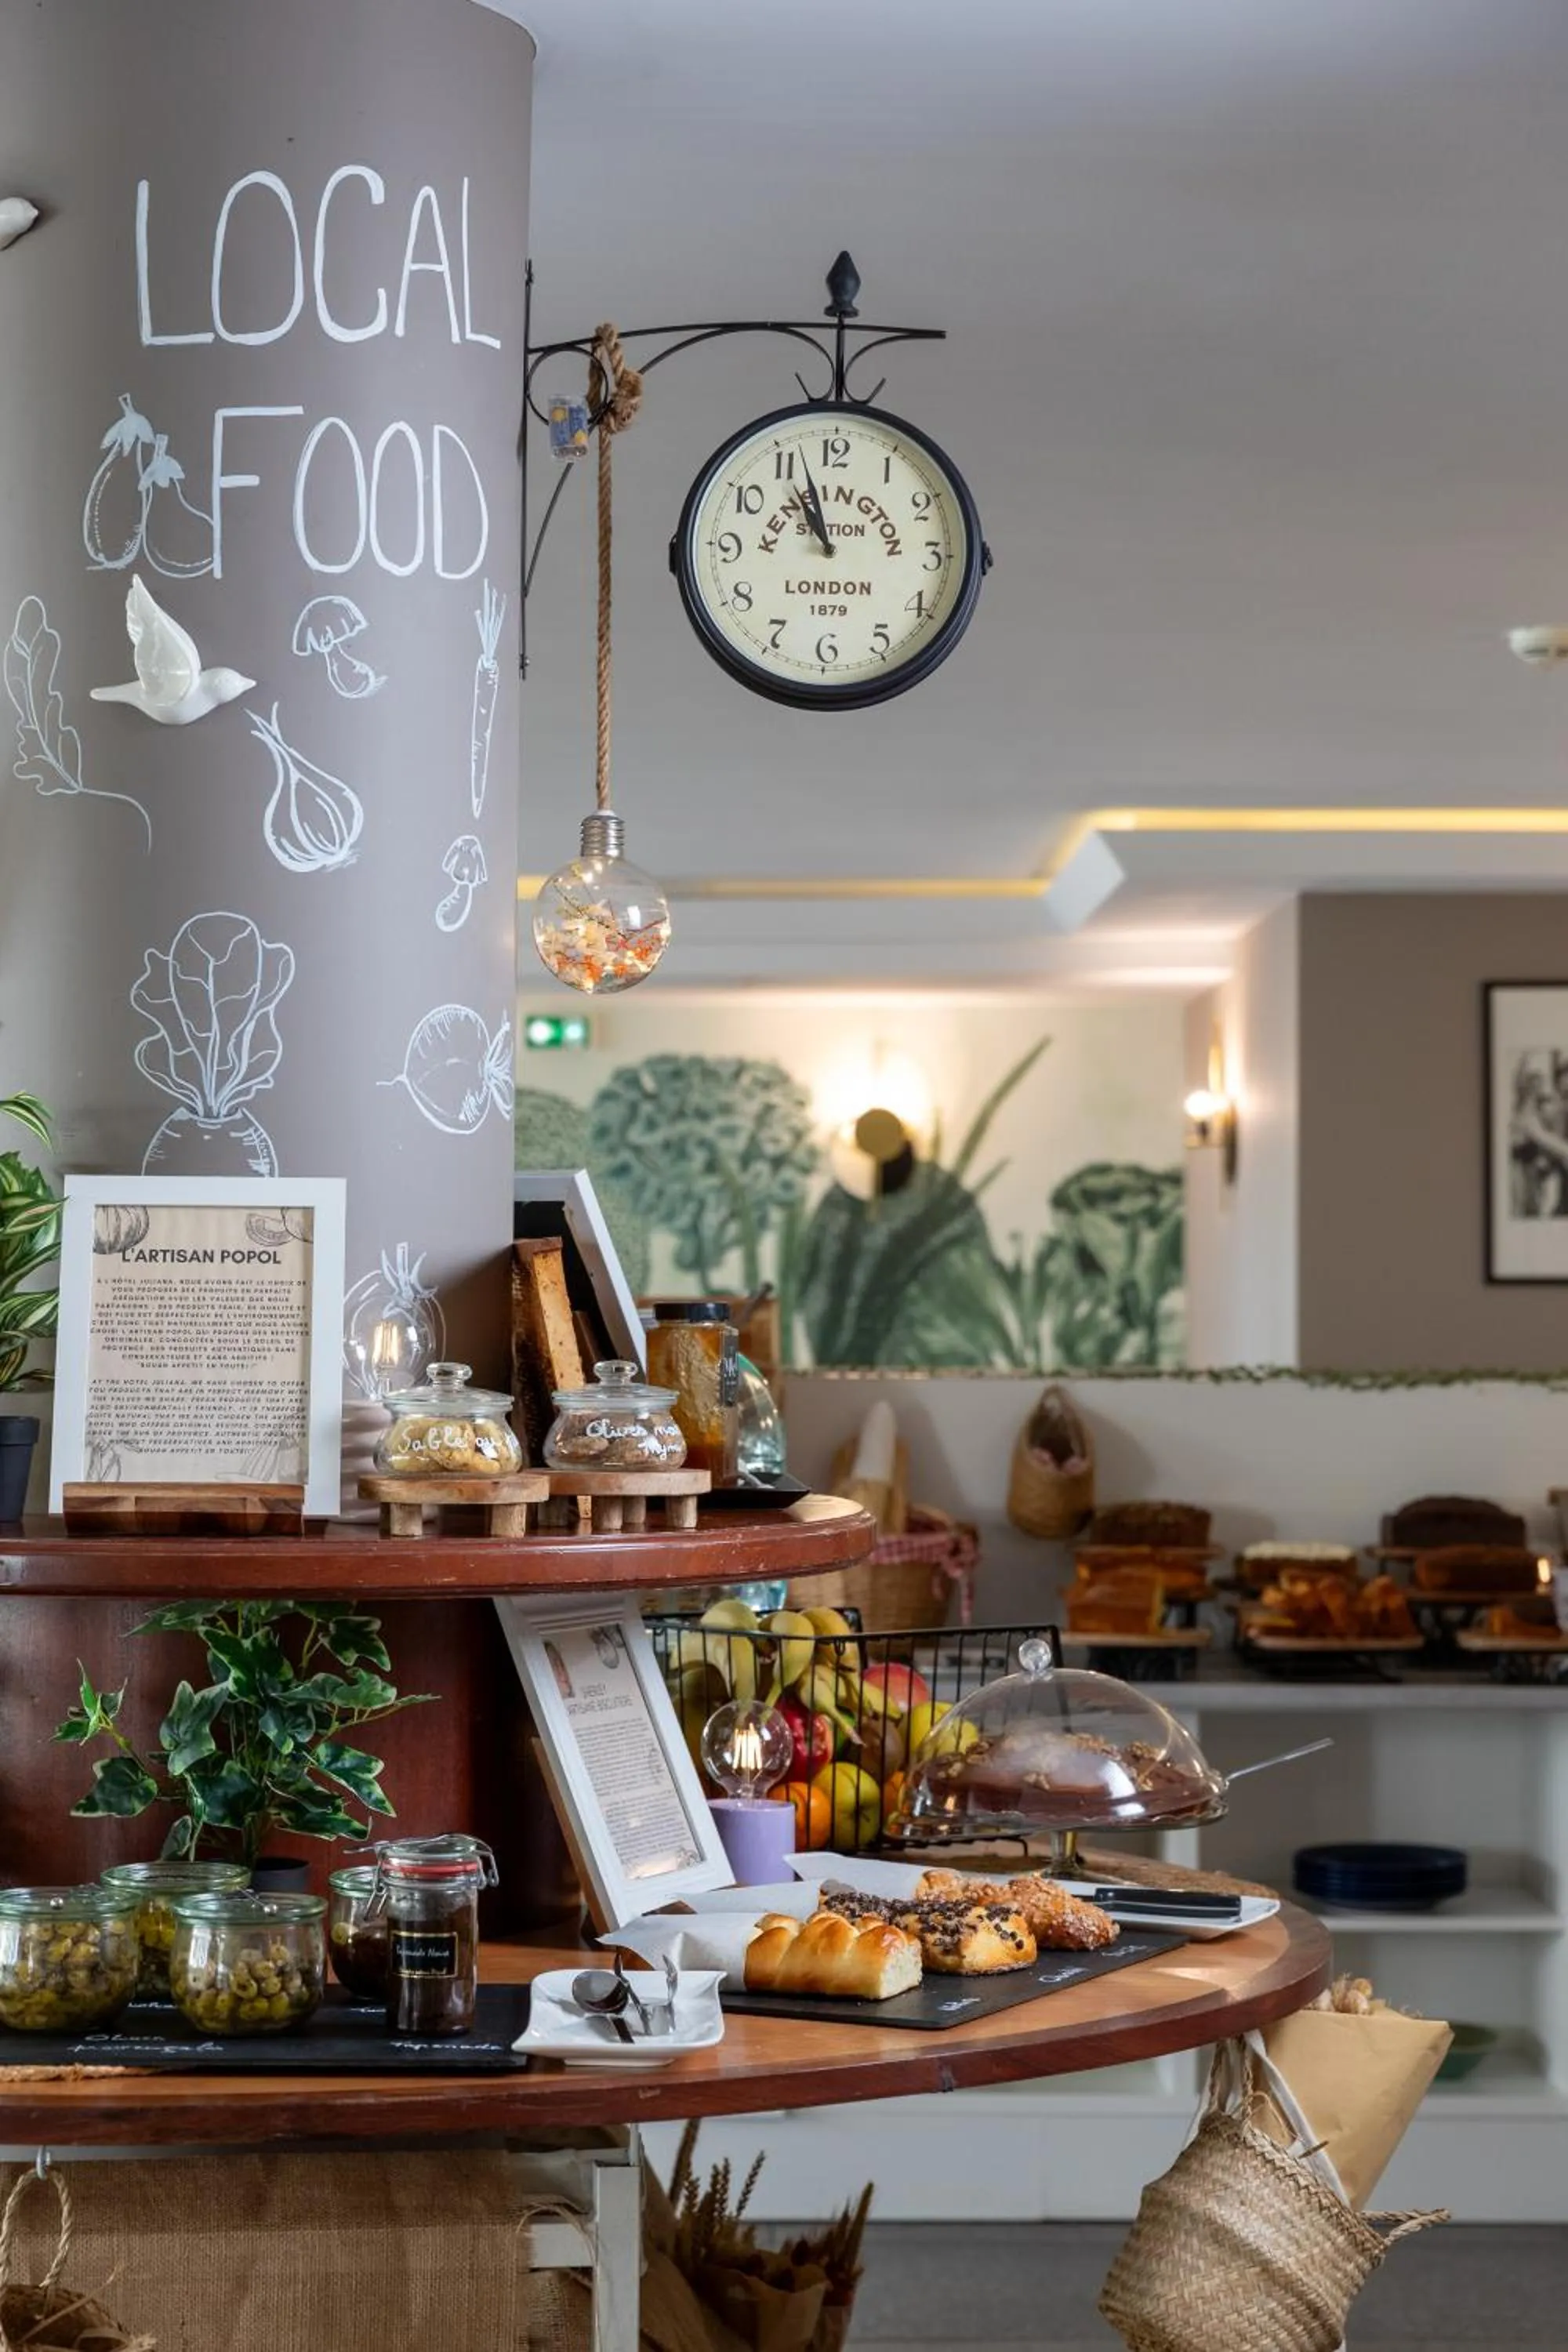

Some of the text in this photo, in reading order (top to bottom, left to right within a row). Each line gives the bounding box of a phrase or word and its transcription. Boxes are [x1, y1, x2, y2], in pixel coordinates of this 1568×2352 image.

[136, 165, 501, 348] LOCAL
[775, 451, 794, 480] 11
[822, 437, 851, 469] 12
[884, 456, 891, 485] 1
[212, 405, 488, 579] FOOD
[735, 484, 765, 515] 10
[911, 491, 931, 522] 2
[796, 523, 866, 537] STTION
[717, 532, 742, 564] 9
[922, 540, 942, 572] 3
[731, 581, 753, 612] 8
[785, 579, 872, 596] LONDON
[810, 604, 848, 617] 1879
[904, 590, 927, 619] 4
[769, 619, 787, 650] 7
[815, 633, 839, 664] 6
[869, 623, 891, 655] 5
[122, 1247, 281, 1264] L'ARTISAN POPOL
